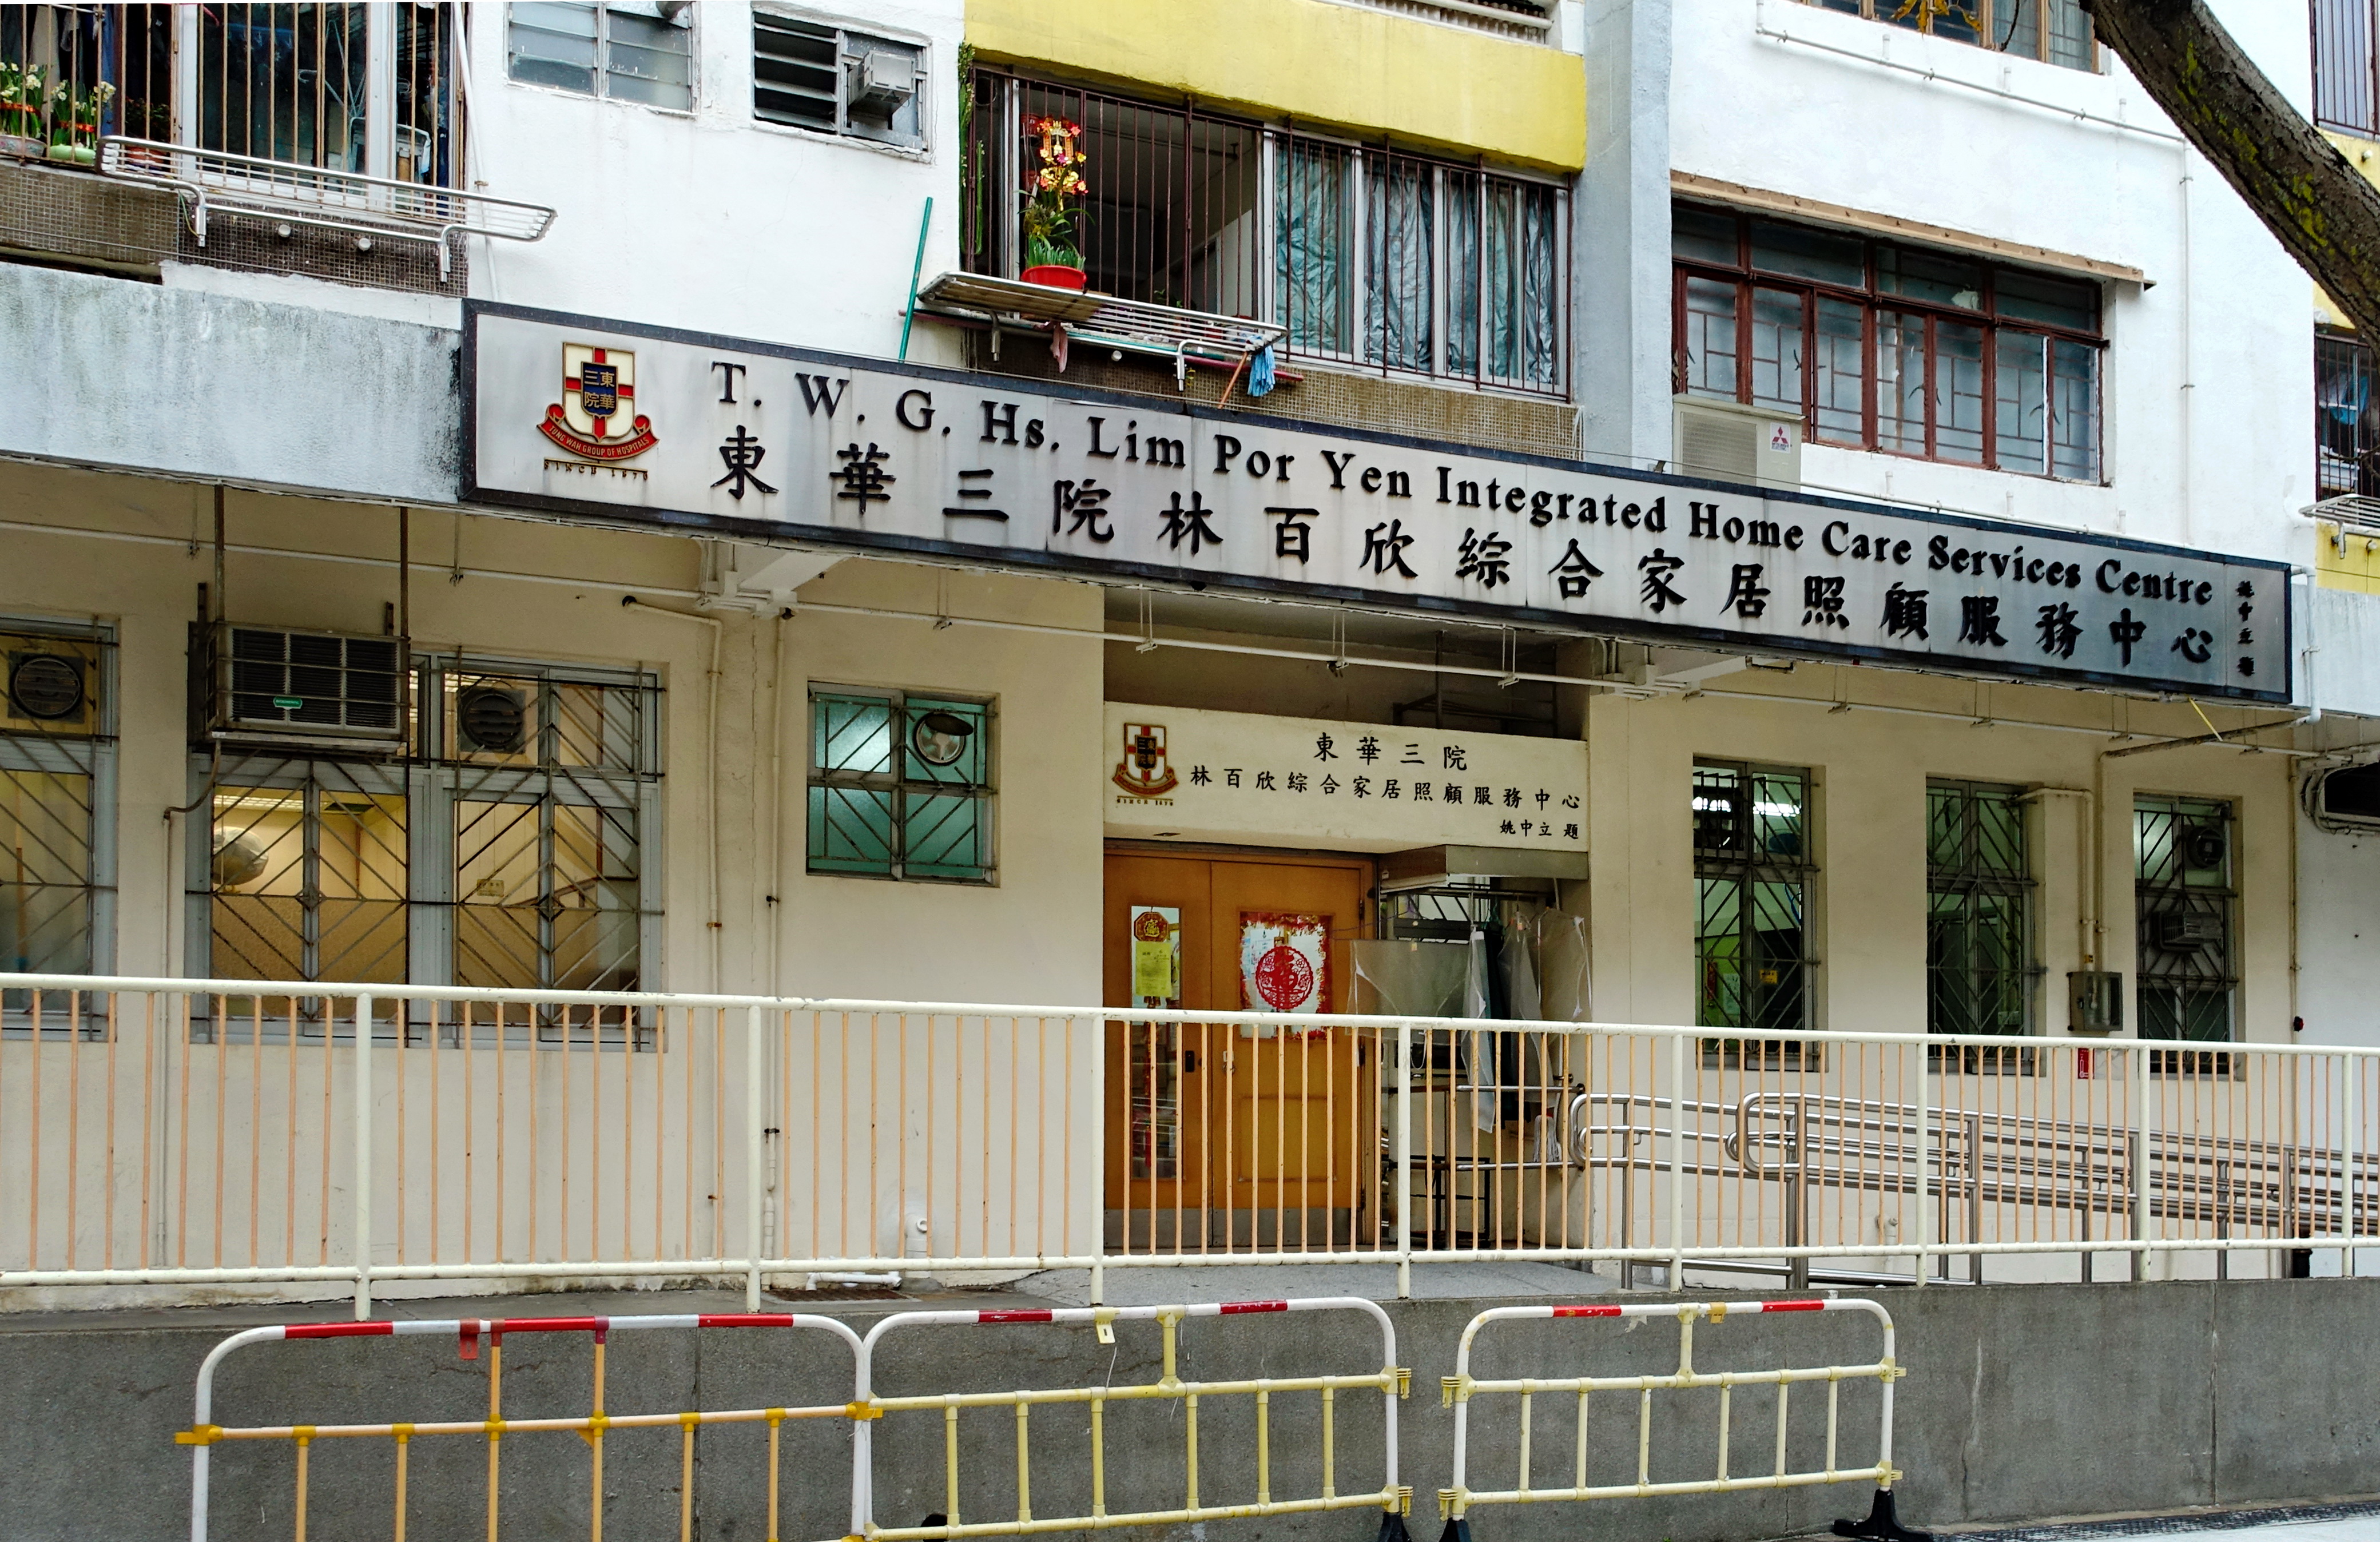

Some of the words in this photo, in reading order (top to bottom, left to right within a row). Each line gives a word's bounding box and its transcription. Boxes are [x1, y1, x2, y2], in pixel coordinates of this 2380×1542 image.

[584, 369, 599, 408] 三院
[599, 372, 615, 410] 東華
[549, 426, 565, 441] TUNG
[566, 437, 582, 451] WAH
[582, 445, 606, 456] GROUP
[607, 448, 616, 456] OF
[617, 437, 650, 455] HOSPITALS
[1087, 416, 1186, 469] Lim
[1214, 434, 1295, 482] Por
[1320, 450, 1412, 498] Yen
[1437, 466, 1668, 533] Integrated
[1688, 501, 1803, 551] Home
[1822, 520, 1912, 565] Care
[1928, 535, 2082, 589] Services
[2095, 559, 2213, 606] Centre
[1313, 732, 1468, 771] 東華三院
[1190, 765, 1580, 811] 林百欣綜合家居照顧服務中心
[1499, 819, 1579, 840] 姚中立題
